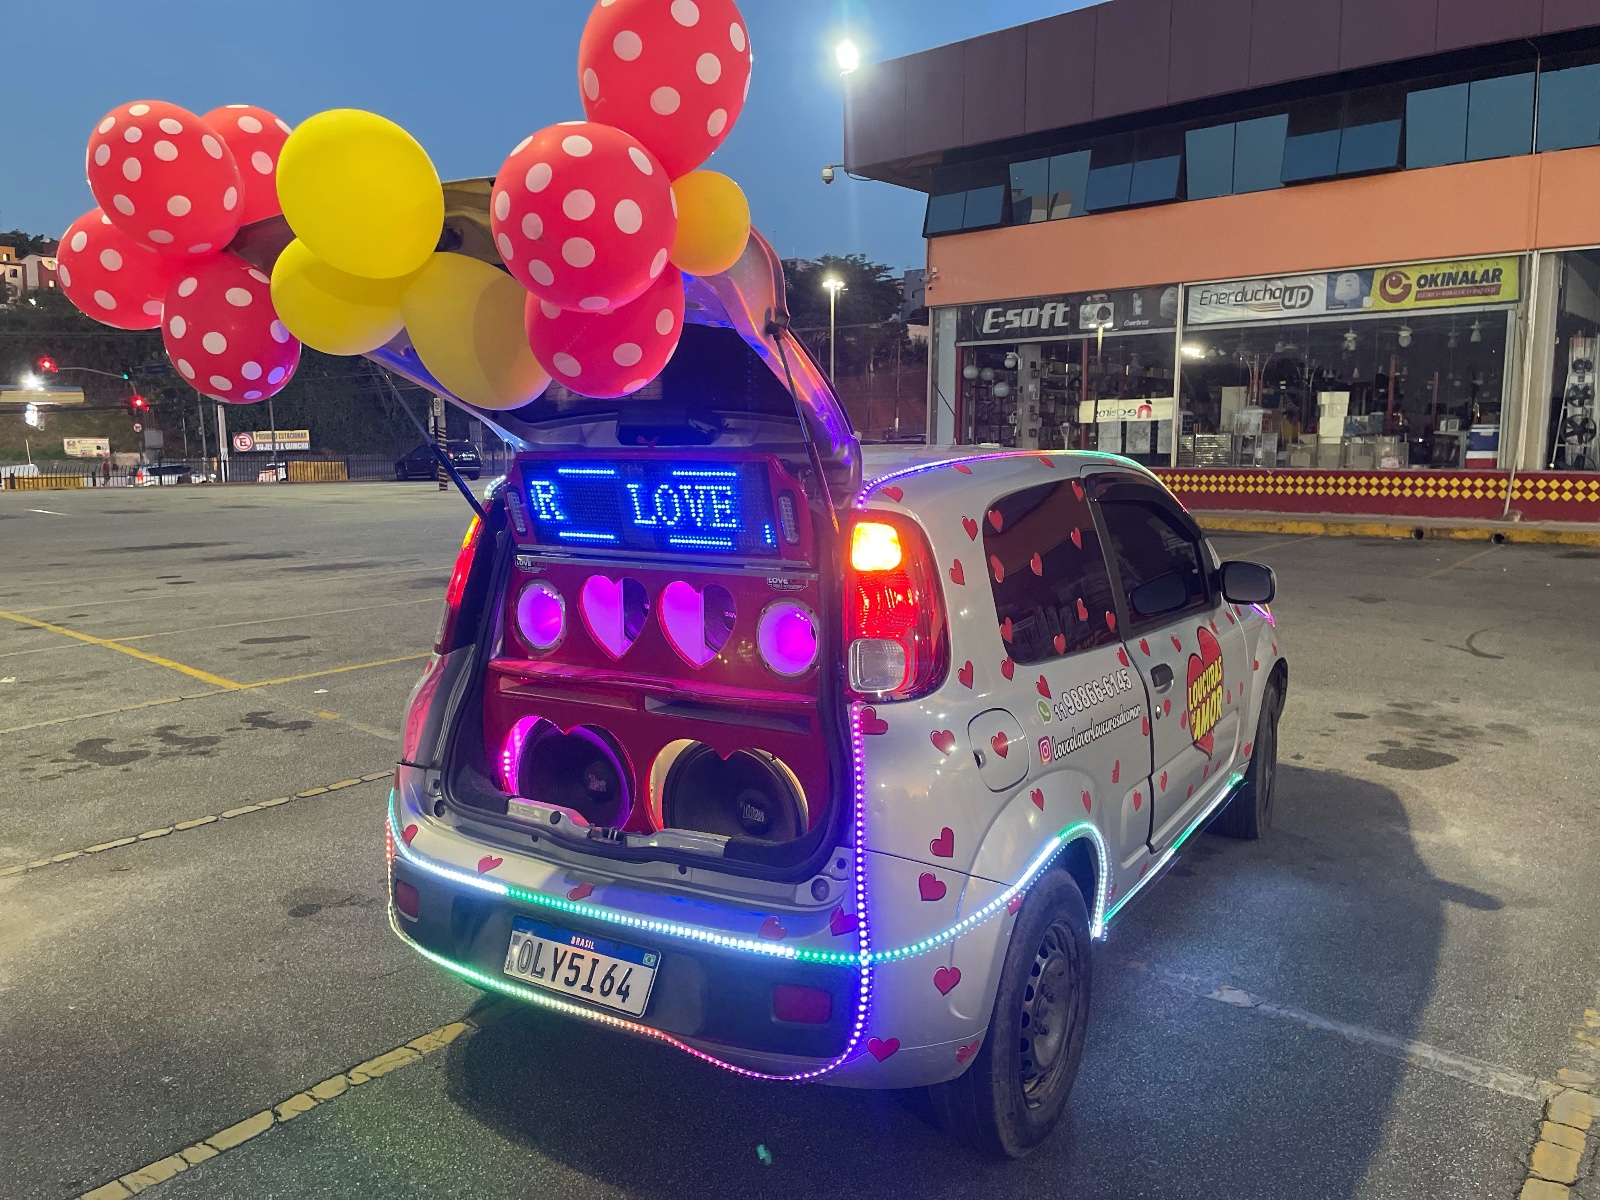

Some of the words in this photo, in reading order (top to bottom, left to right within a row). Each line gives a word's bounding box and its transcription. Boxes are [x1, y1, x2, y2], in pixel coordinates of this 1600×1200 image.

[1416, 267, 1503, 289] OKINALAR
[531, 480, 564, 520] R
[626, 483, 737, 527] LOVE
[1054, 702, 1068, 721] 11
[1062, 668, 1132, 716] 98866-6145
[1188, 655, 1222, 712] LOUCURAS
[1193, 684, 1223, 741] AMOR
[570, 935, 595, 950] BRASIL
[517, 938, 634, 1004] OLY5I64
